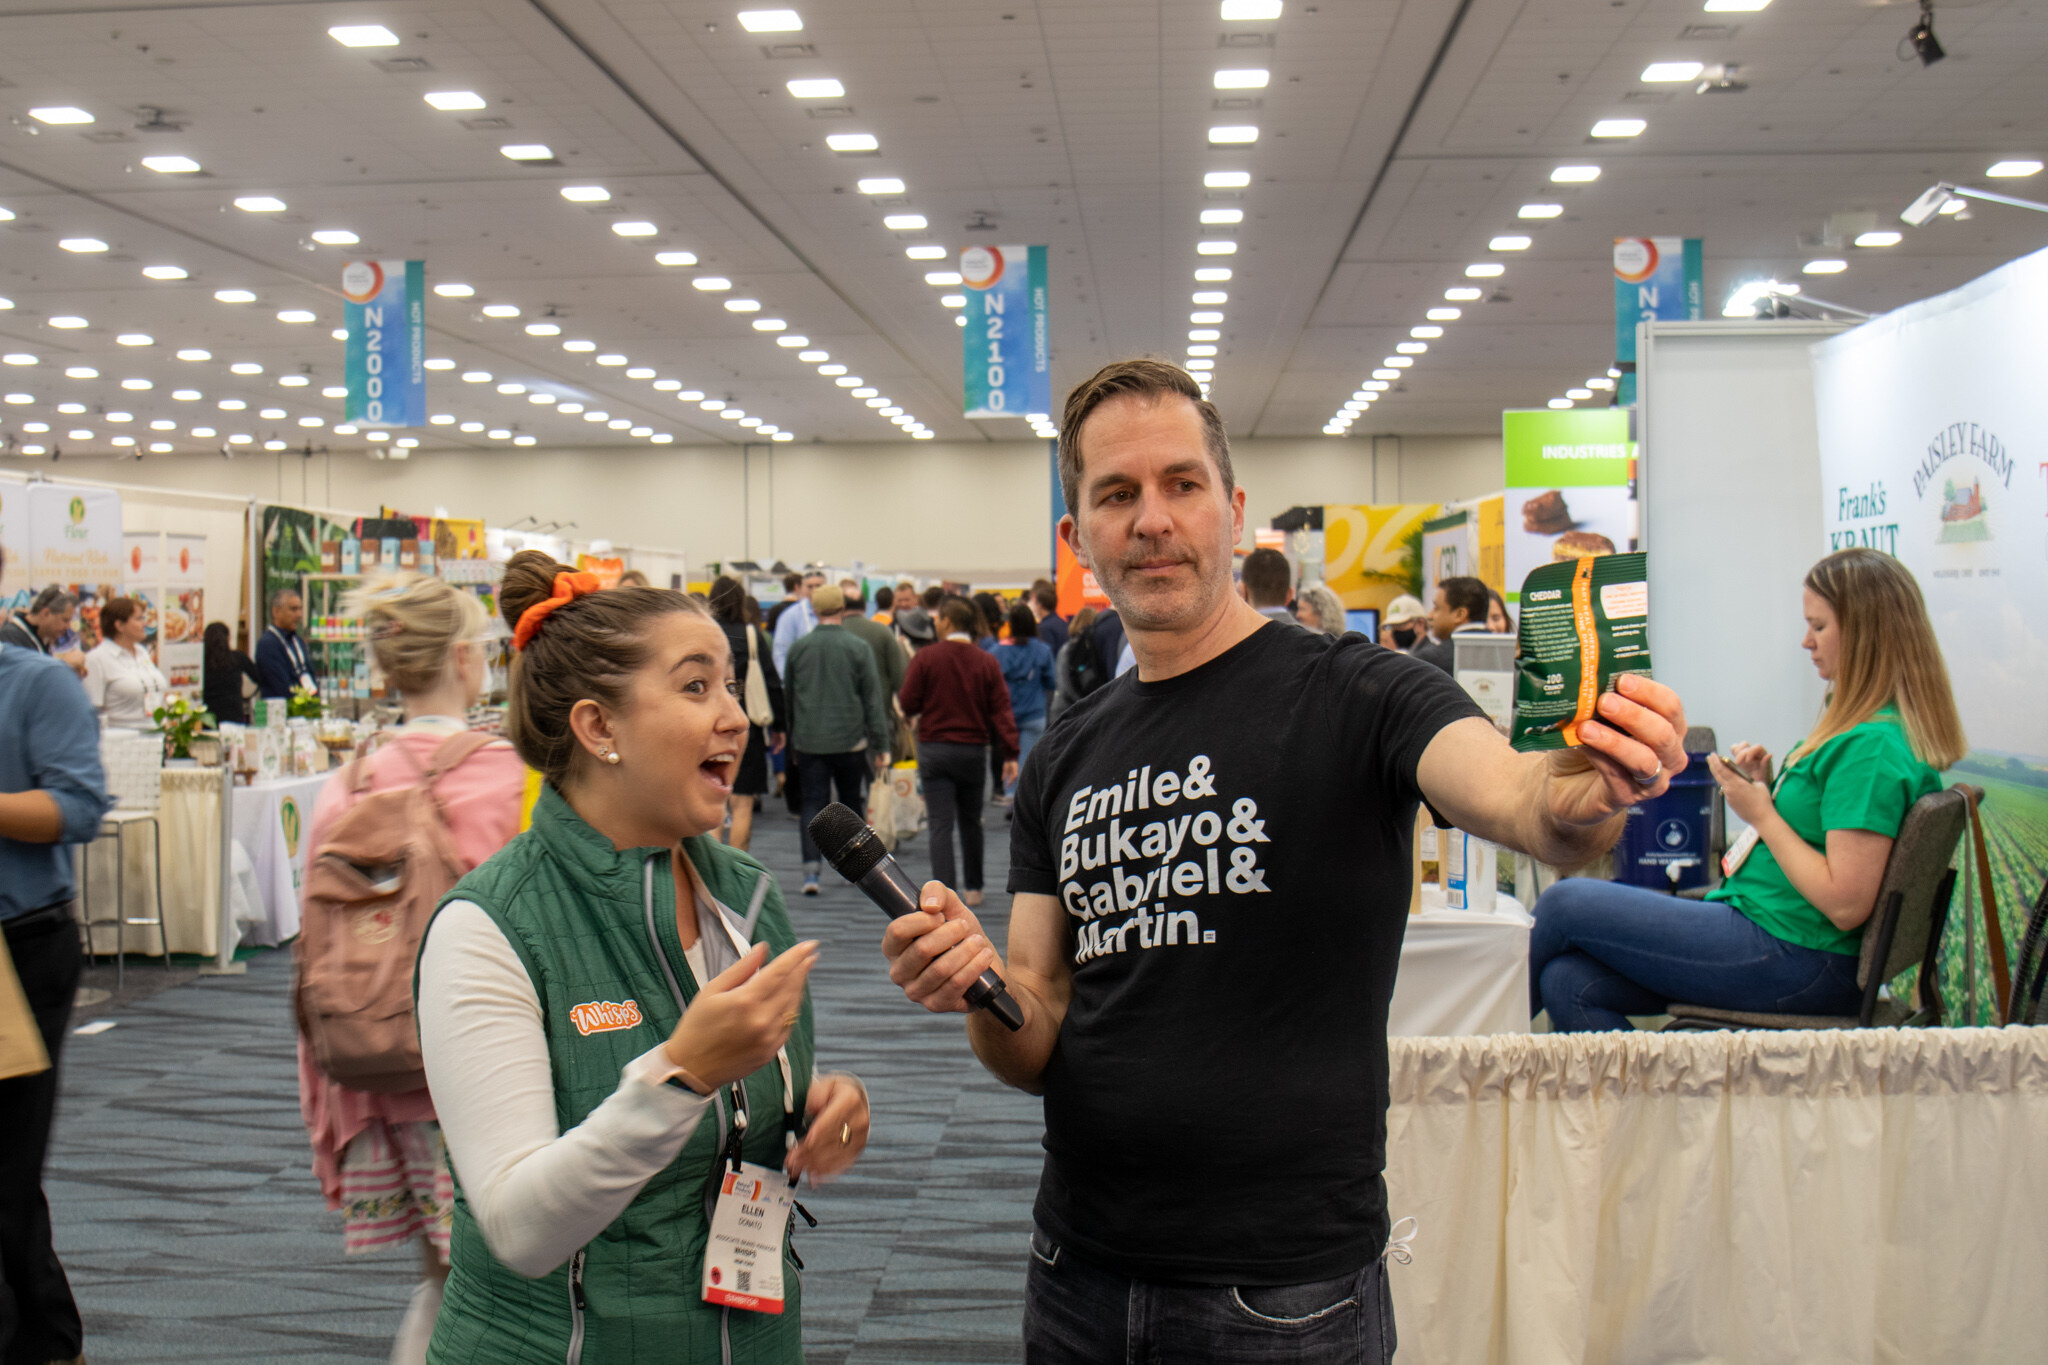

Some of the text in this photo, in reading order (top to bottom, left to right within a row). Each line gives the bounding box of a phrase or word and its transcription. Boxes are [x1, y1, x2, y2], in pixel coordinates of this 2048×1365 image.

[1688, 281, 1700, 305] HOT
[411, 301, 422, 385] HOT PRODUCTS
[1034, 287, 1046, 373] HOT PRODUCTS
[364, 306, 383, 422] N2000
[984, 293, 1005, 410] N2100
[1542, 443, 1627, 460] INDUSTRIES
[1913, 421, 1967, 500] PAISLEY
[1970, 422, 2015, 490] FARM
[1838, 480, 1887, 522] Frank's
[1529, 589, 1562, 602] CHEDDAR
[571, 1001, 639, 1032] Whisps
[741, 1203, 766, 1218] ELLEN
